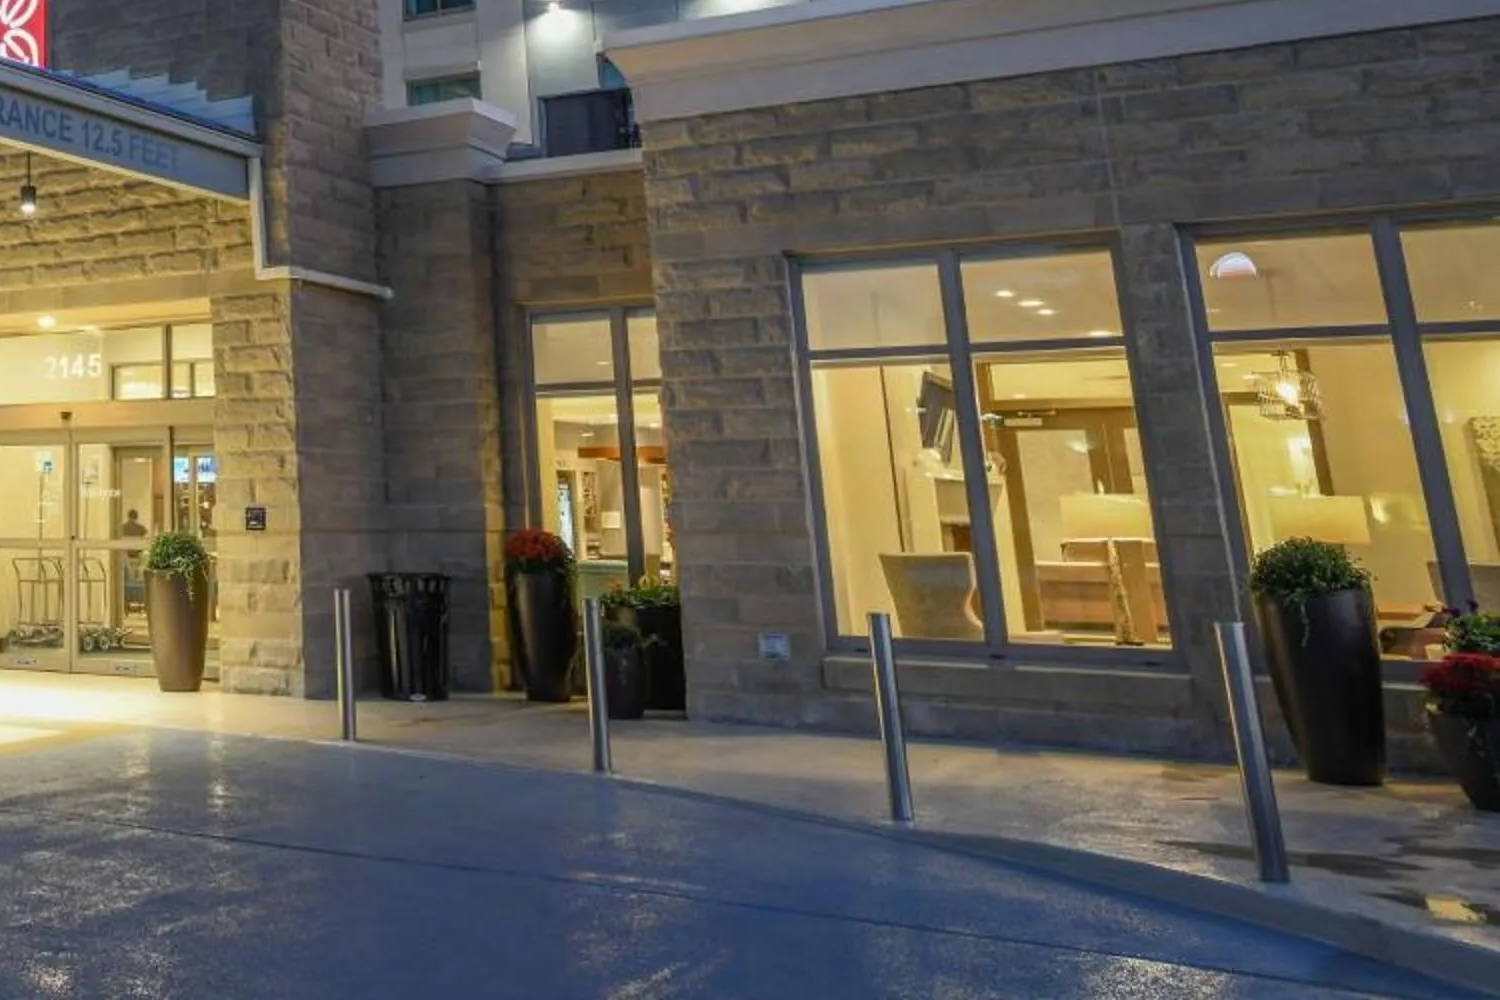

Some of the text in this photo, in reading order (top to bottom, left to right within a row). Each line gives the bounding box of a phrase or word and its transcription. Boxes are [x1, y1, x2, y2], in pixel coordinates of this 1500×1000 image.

[82, 119, 123, 157] 12.5
[129, 135, 180, 171] FEET
[44, 353, 102, 379] 2145
